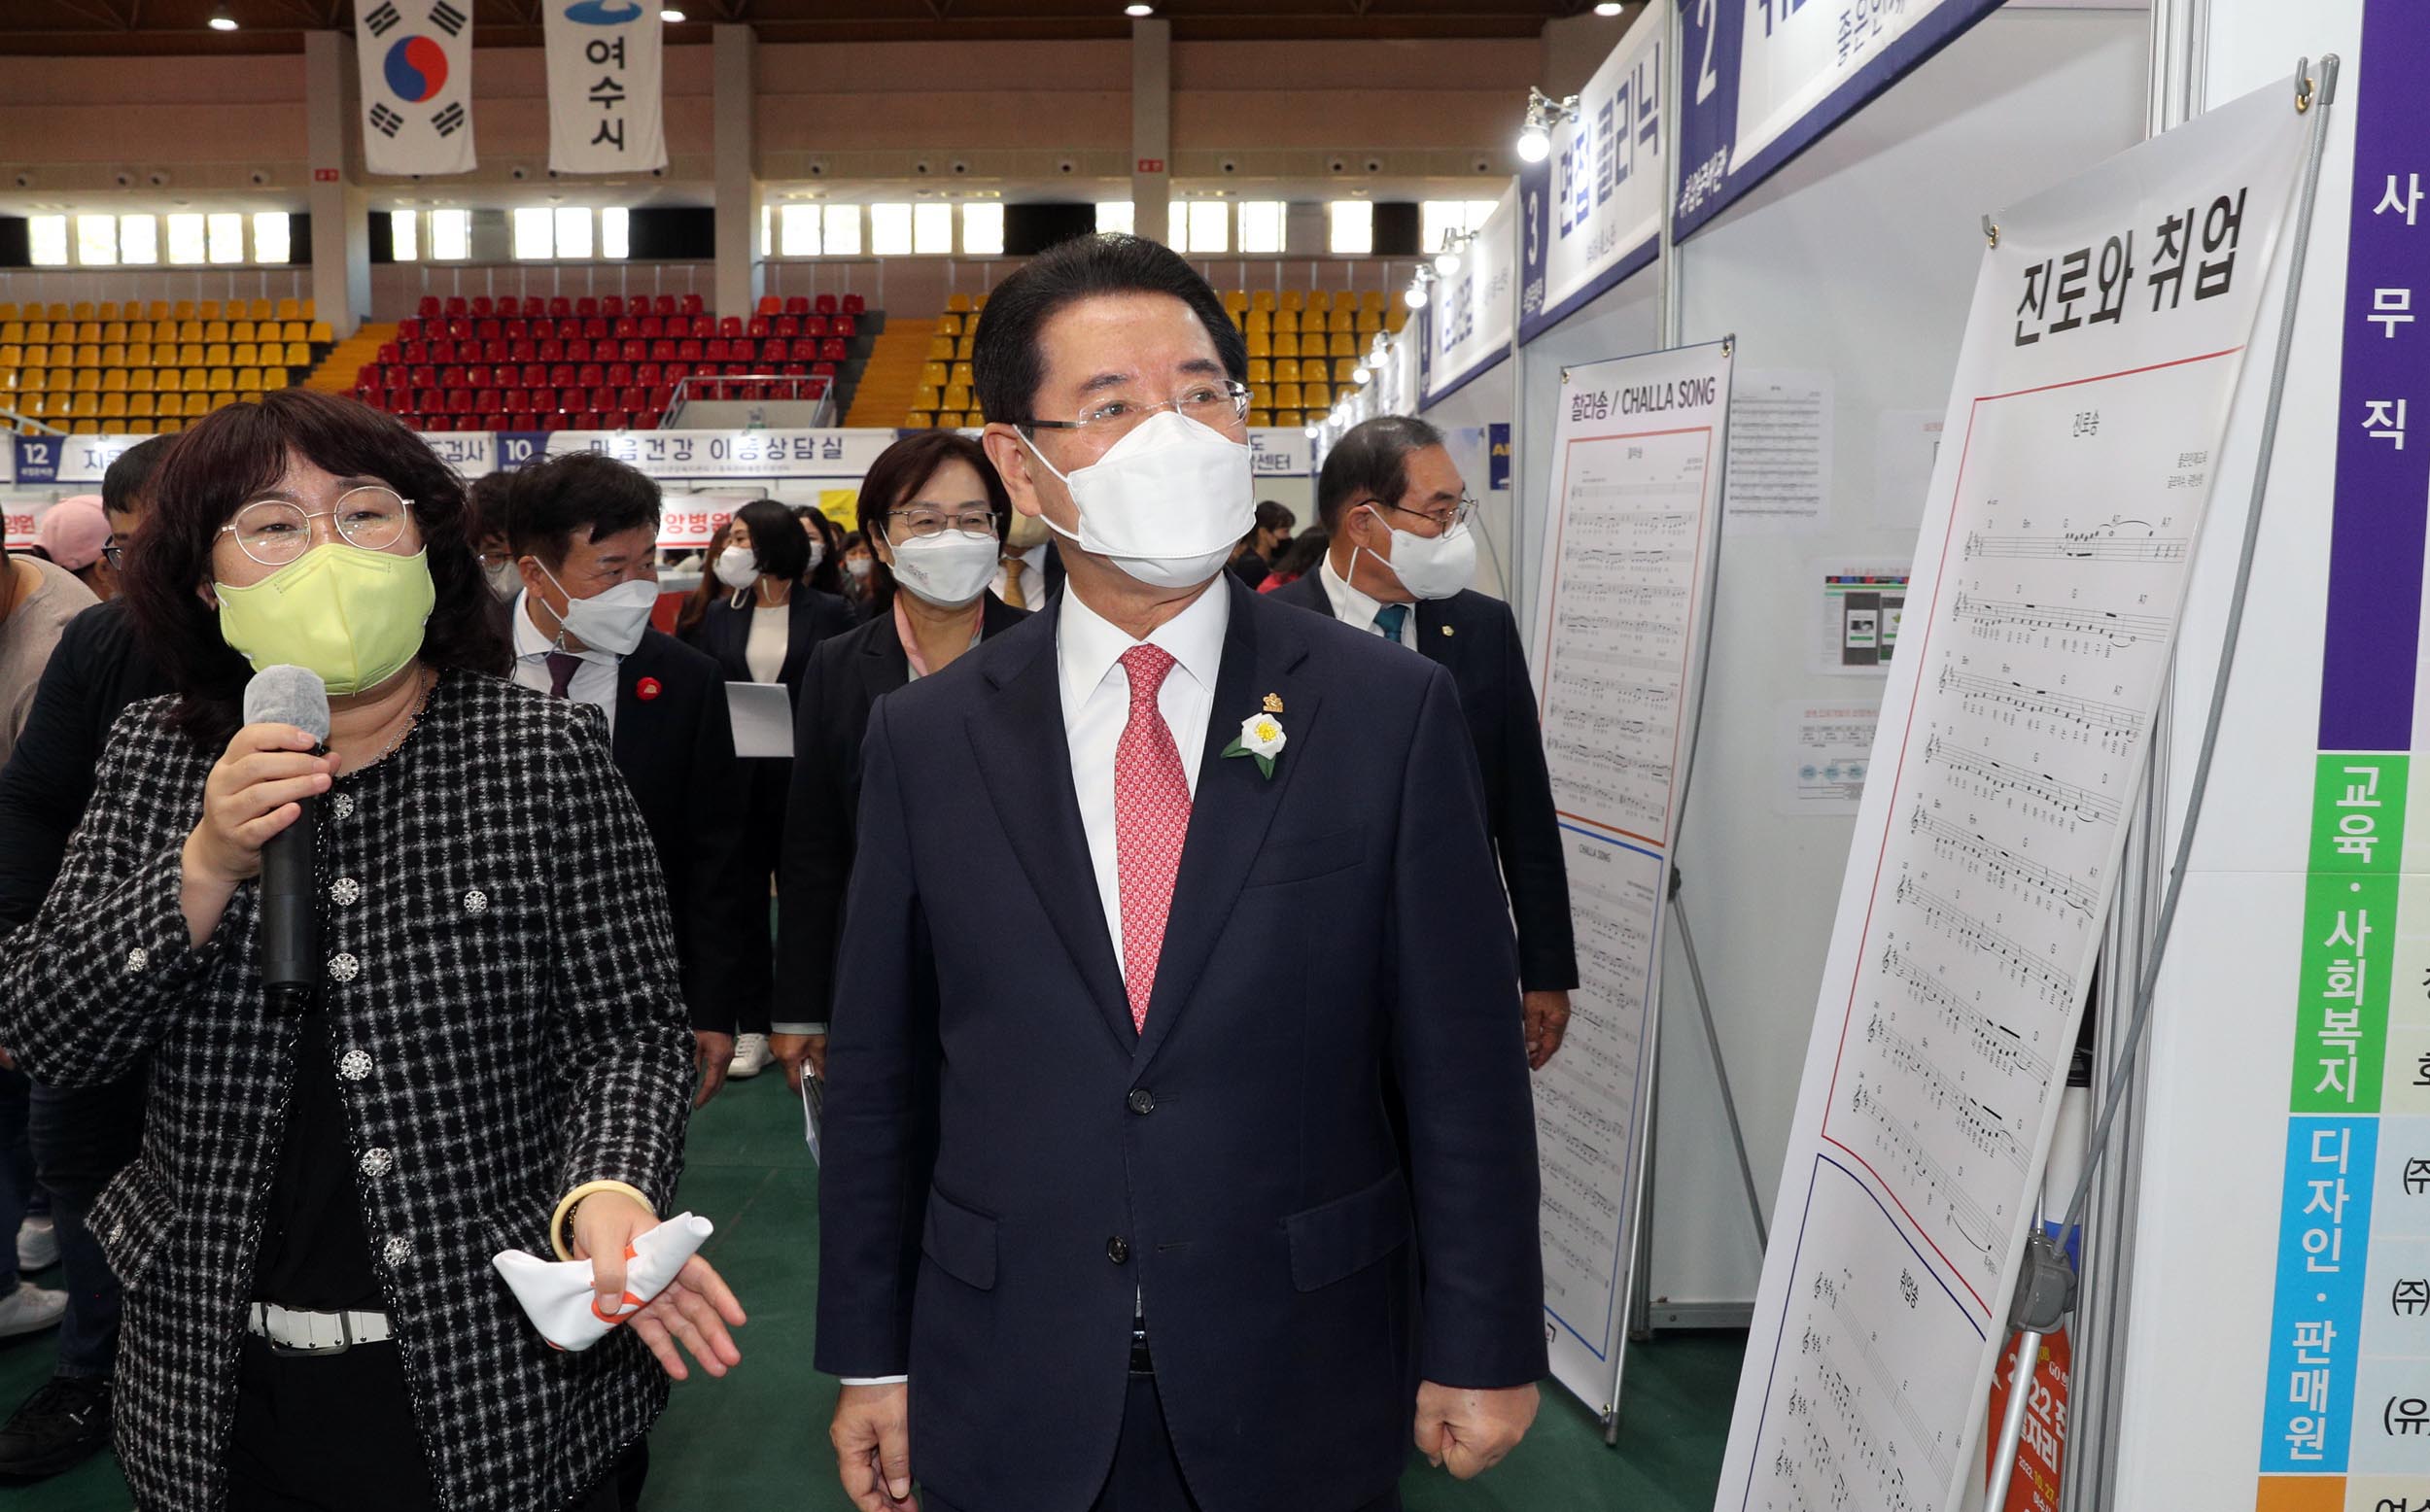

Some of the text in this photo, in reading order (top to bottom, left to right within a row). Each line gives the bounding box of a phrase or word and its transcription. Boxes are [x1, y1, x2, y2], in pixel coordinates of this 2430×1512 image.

[1696, 0, 1717, 105] 2
[585, 36, 625, 152] 여수시
[1598, 41, 1659, 207] 클리닉
[1527, 191, 1538, 266] 3
[2015, 187, 2247, 347] 진로와 취업
[2362, 173, 2425, 450] 사무직
[1621, 383, 1674, 415] CHALLA
[1678, 376, 1716, 409] SONG
[2073, 410, 2100, 437] 진로송
[23, 443, 49, 464] 12
[428, 440, 484, 462] 검사
[505, 439, 533, 461] 10
[590, 437, 843, 462] 마음건강 이동상담실
[1251, 454, 1291, 470] 센터
[2384, 1395, 2430, 1436] (유
